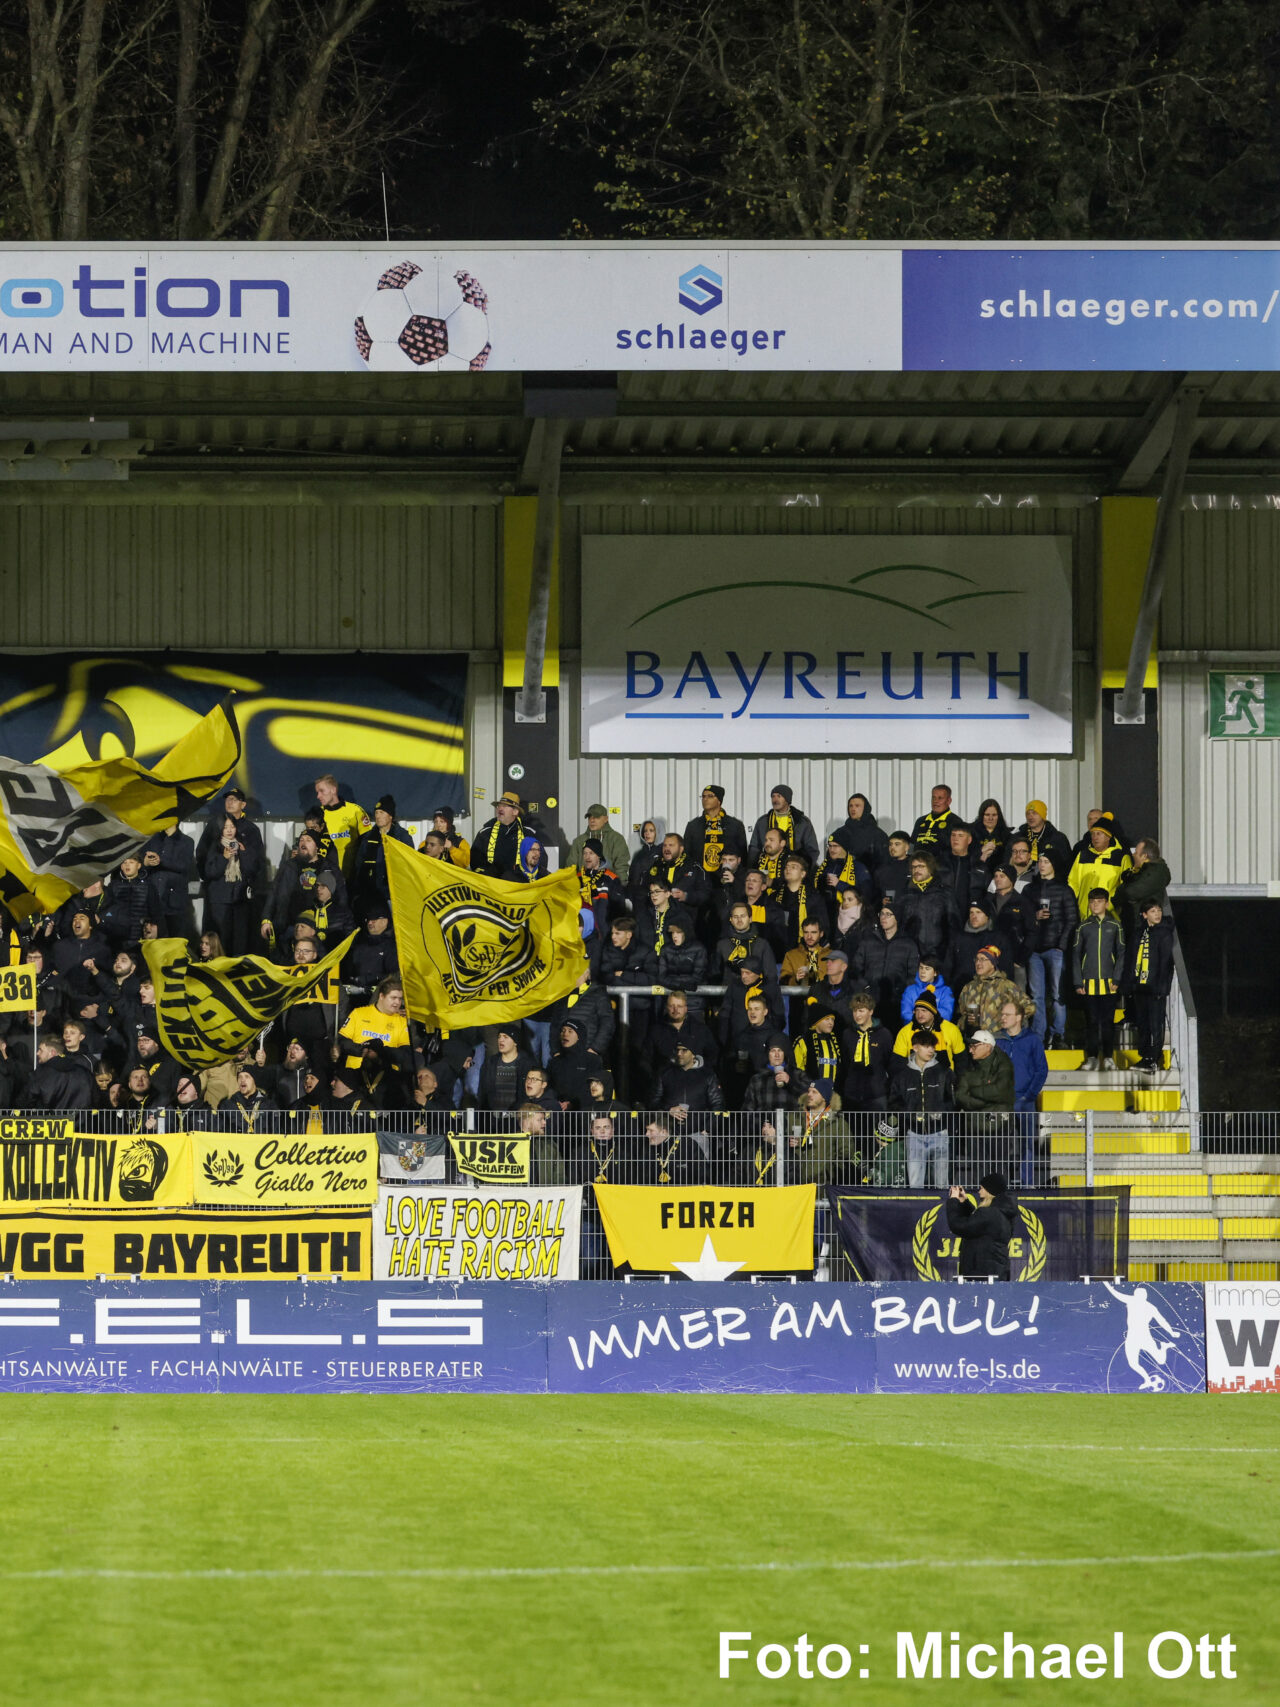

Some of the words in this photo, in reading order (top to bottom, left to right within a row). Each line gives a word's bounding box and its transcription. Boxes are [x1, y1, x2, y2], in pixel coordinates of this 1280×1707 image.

[980, 290, 1279, 325] schlaeger.com/
[69, 332, 134, 354] AND
[151, 332, 290, 354] MACHINE
[616, 322, 786, 356] schlaeger
[254, 1139, 367, 1171] Collettivo
[459, 1140, 518, 1165] USK
[3, 1139, 118, 1202] KOLLEKTIV
[255, 1170, 314, 1199] Giallo
[321, 1170, 368, 1192] Nero
[385, 1196, 445, 1236] LOVE
[451, 1198, 566, 1238] FOOTBALL
[661, 1201, 755, 1229] FORZA
[115, 1231, 360, 1273] BAYREUTH
[390, 1237, 451, 1278] HATE
[459, 1239, 561, 1279] RACISM
[567, 1307, 751, 1371] IMMER
[769, 1299, 853, 1341] AM
[871, 1295, 1040, 1336] BALL!
[151, 1356, 303, 1378] FACHANWÄLTE
[326, 1358, 483, 1378] STEUERBERATER
[894, 1358, 1041, 1381] www.fe-ls.de
